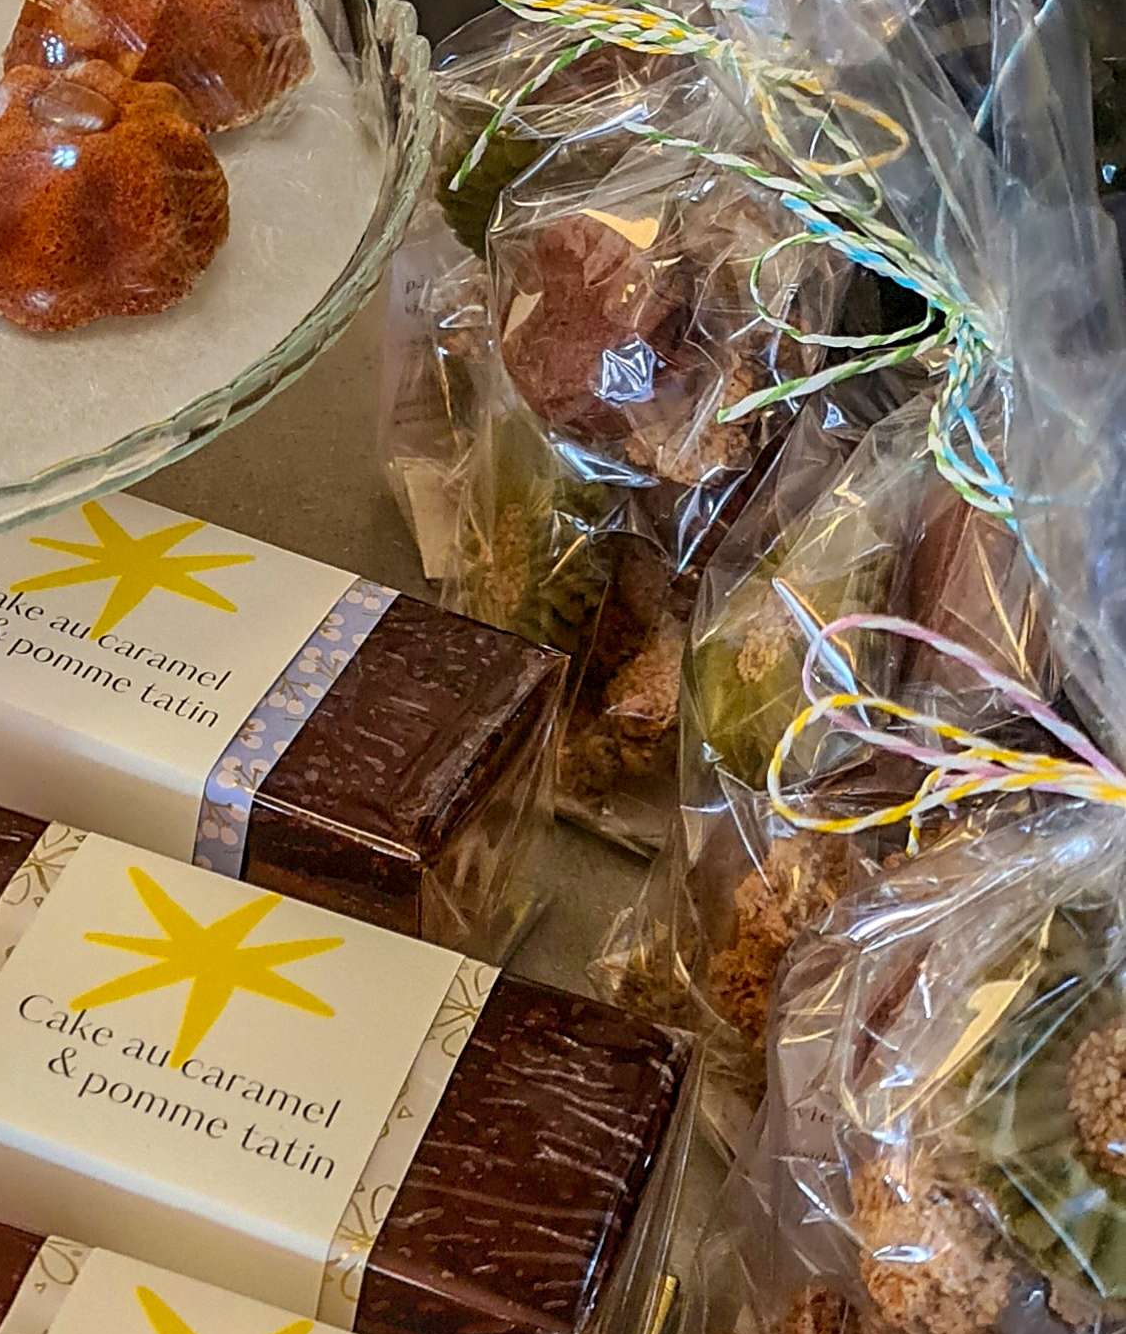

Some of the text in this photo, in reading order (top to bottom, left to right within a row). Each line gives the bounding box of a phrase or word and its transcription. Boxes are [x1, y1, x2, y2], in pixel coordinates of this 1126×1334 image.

[8, 636, 132, 694] pomme
[141, 685, 220, 729] tatin
[50, 611, 91, 640] au
[98, 633, 231, 691] caramel
[19, 993, 341, 1128] Cake au caramel
[47, 1048, 337, 1181] & pomme tatin
